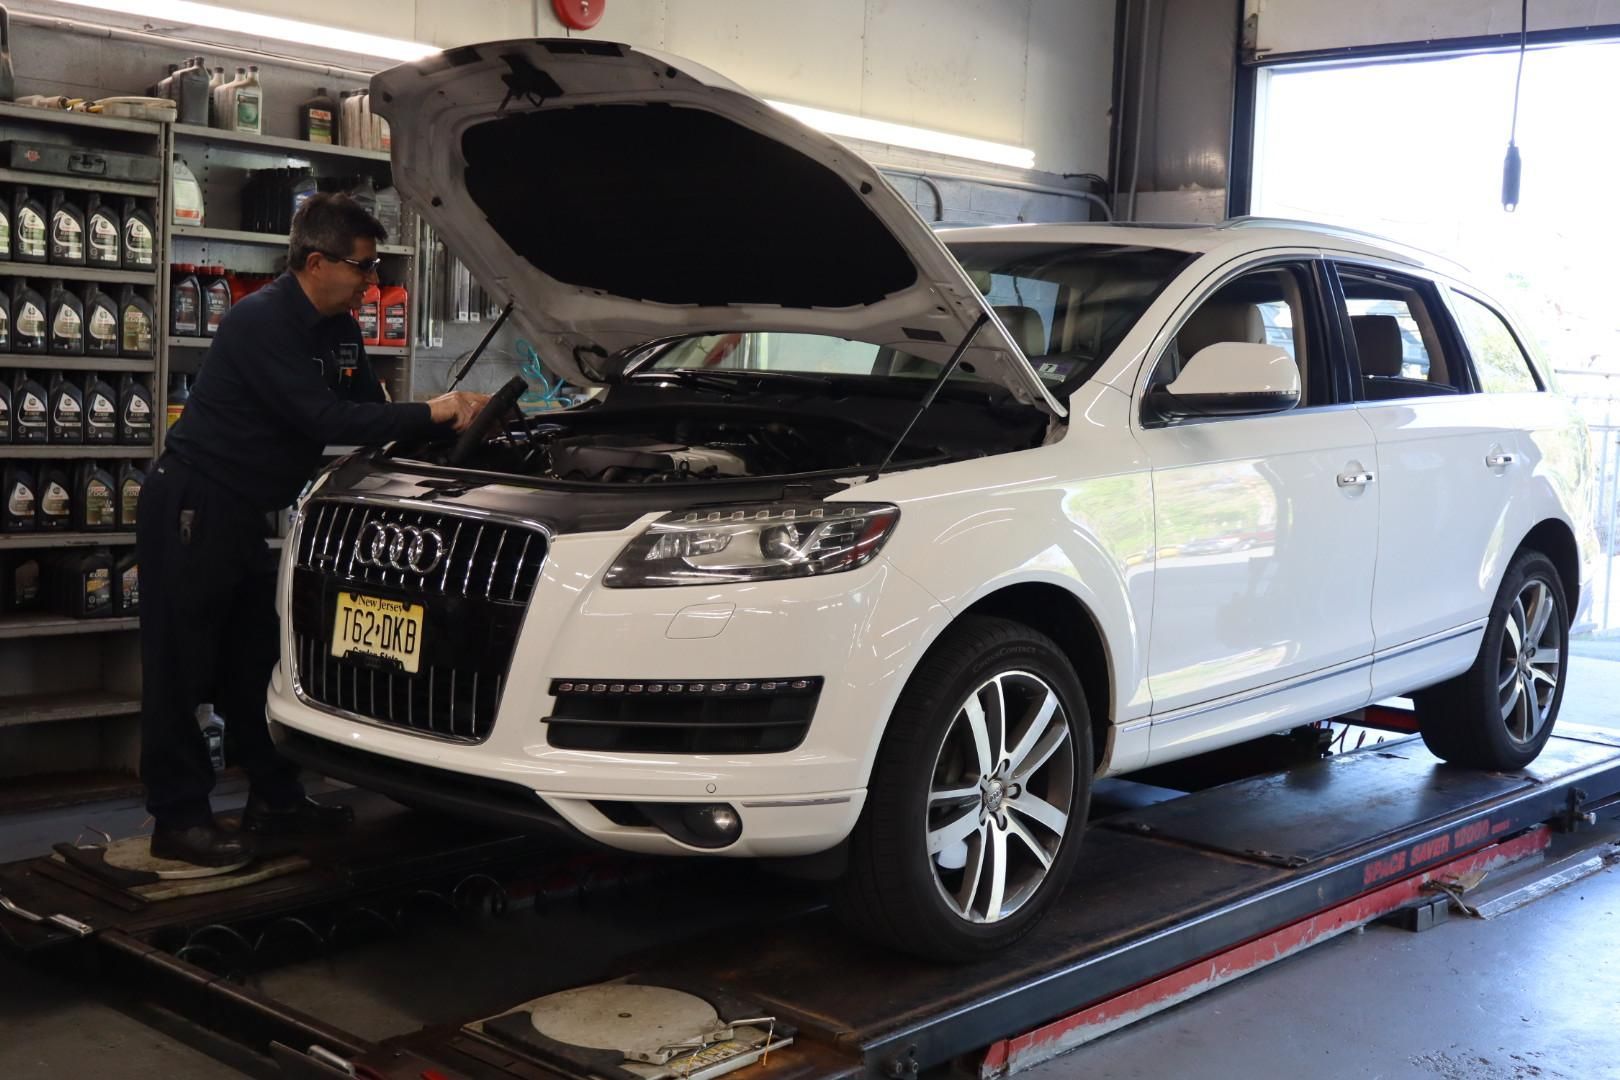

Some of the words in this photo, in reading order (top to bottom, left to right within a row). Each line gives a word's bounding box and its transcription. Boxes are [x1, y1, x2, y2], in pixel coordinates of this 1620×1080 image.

[358, 594, 377, 608] New
[377, 600, 403, 615] Jersey
[1364, 851, 1406, 884] SPACE
[1411, 835, 1449, 866] SAVER
